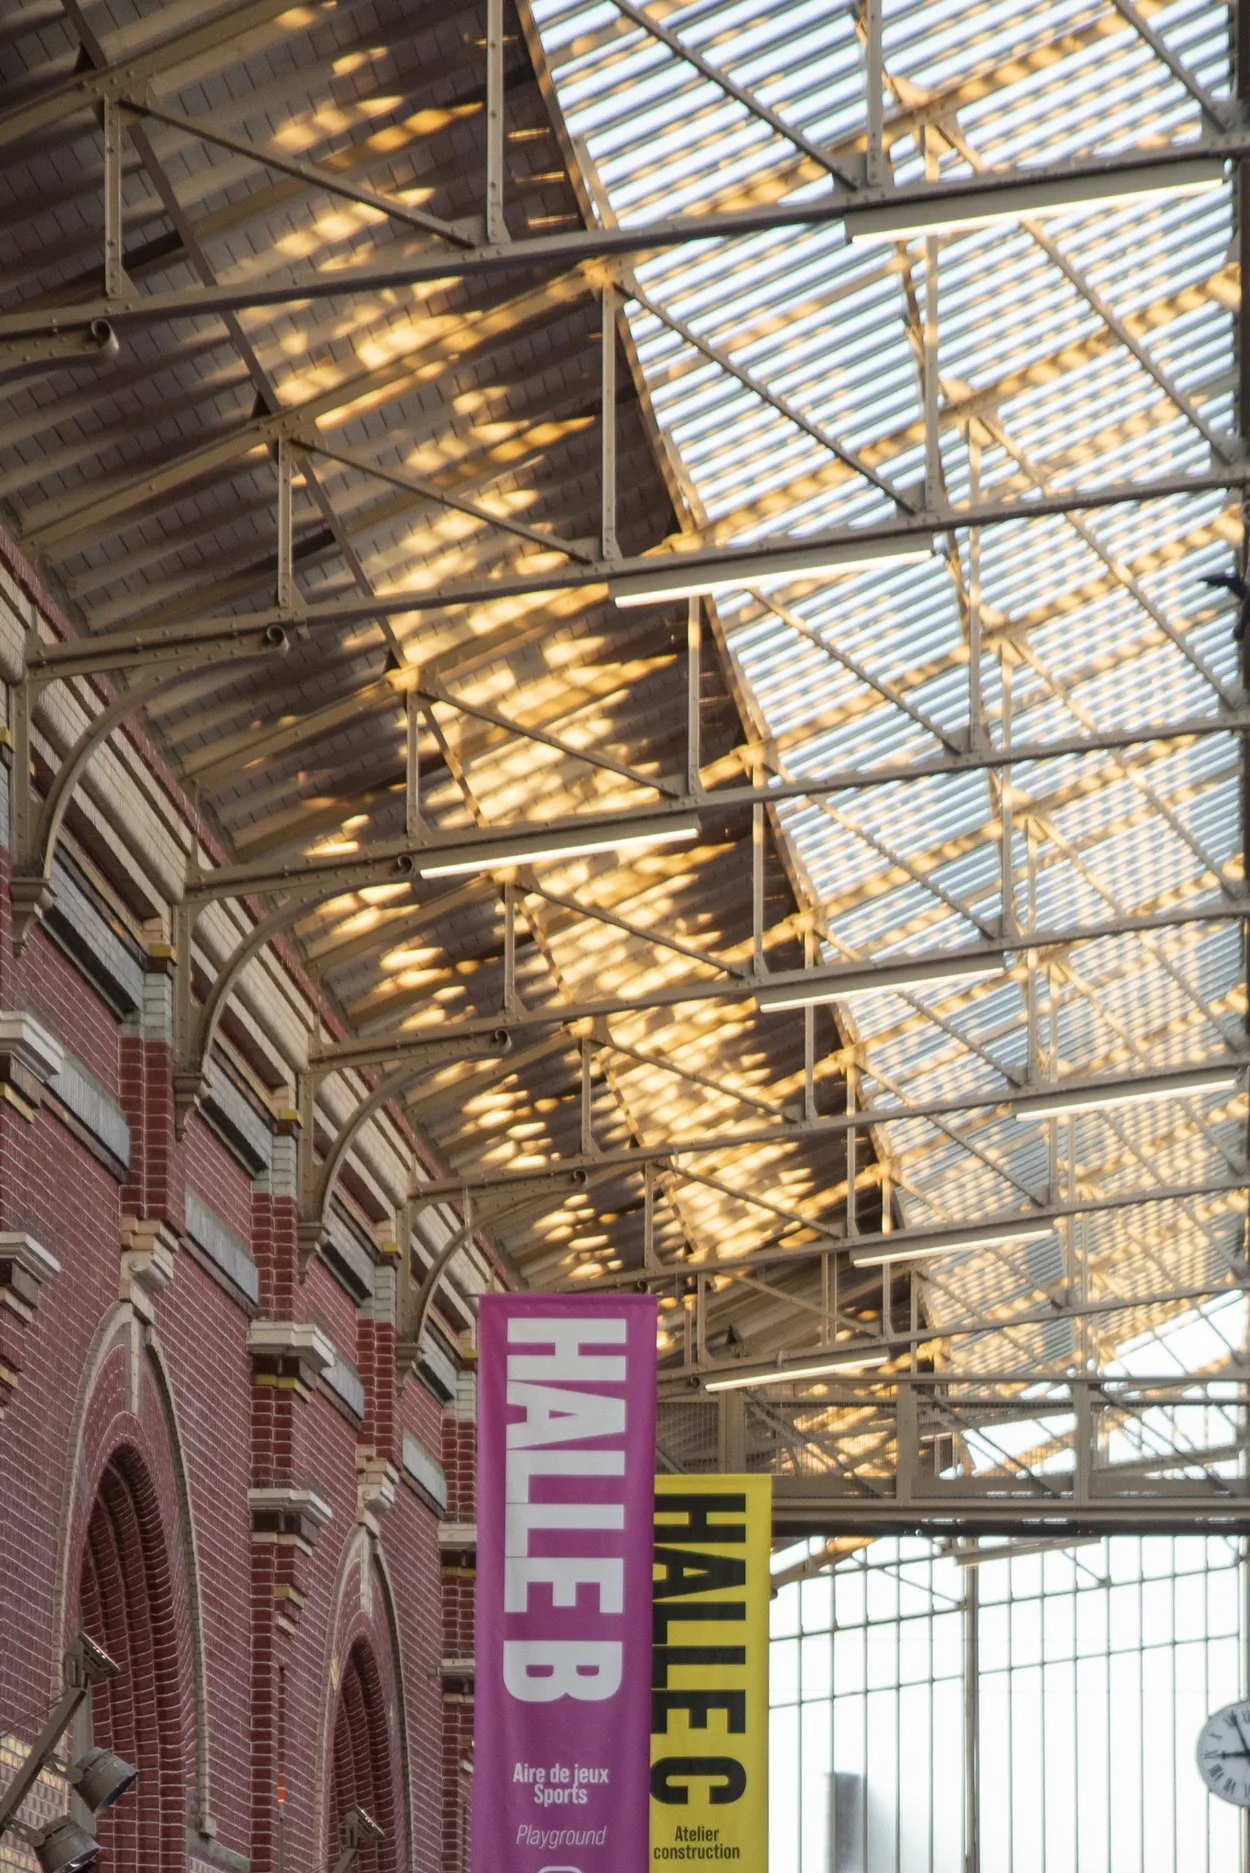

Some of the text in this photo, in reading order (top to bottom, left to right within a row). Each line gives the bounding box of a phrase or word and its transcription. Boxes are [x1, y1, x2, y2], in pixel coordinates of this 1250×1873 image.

[503, 1317, 627, 1702] HALLE B
[650, 1493, 747, 1805] HALLE C
[513, 1763, 609, 1786] Aire de jeux
[534, 1784, 588, 1807] Sports
[516, 1825, 607, 1849] Playground
[675, 1826, 719, 1842] Atelier
[653, 1844, 740, 1859] construction
